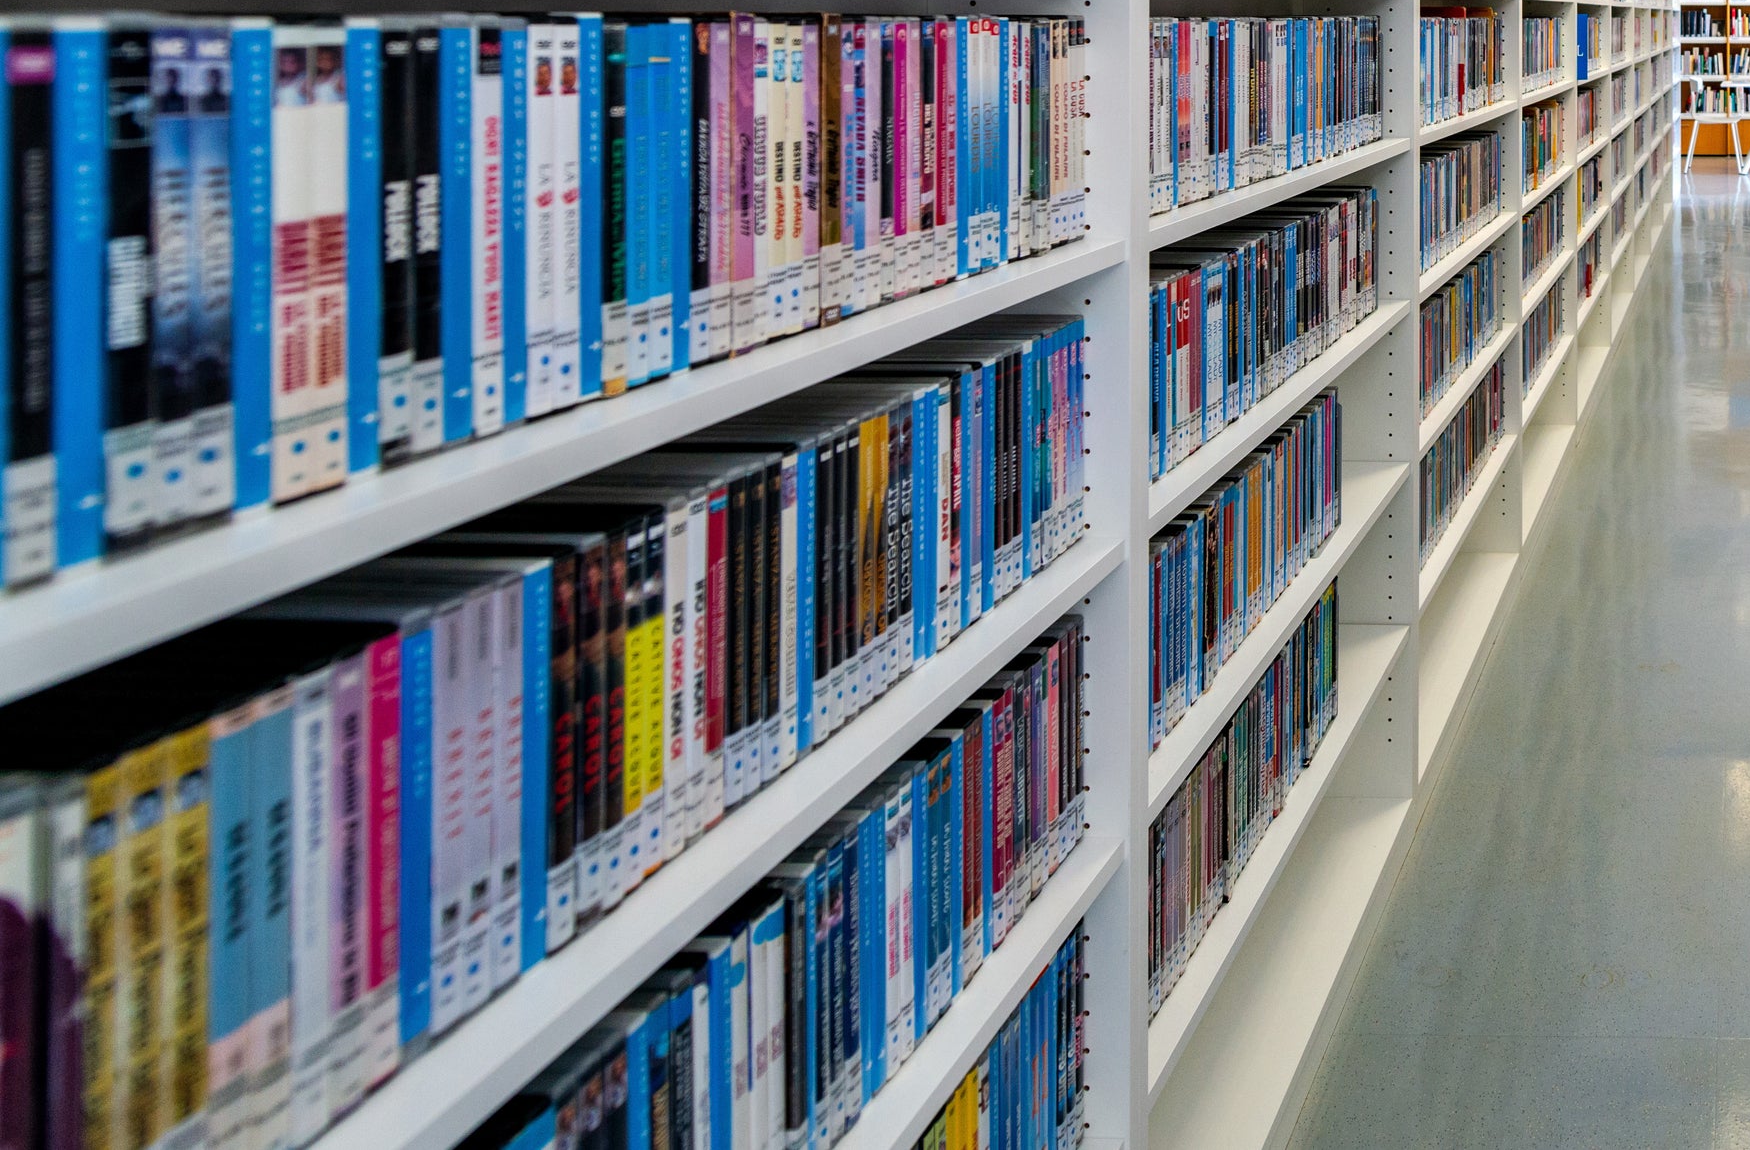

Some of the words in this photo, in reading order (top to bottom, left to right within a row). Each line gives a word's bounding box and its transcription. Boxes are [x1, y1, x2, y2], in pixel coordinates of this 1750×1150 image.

[855, 97, 866, 151] NEVADA
[948, 94, 956, 107] IL
[948, 112, 956, 126] 13
[754, 114, 767, 176] CIRCUS
[948, 131, 956, 151] NON
[971, 106, 980, 173] LOURDES
[1054, 123, 1059, 133] DI
[539, 164, 550, 186] LA
[855, 157, 866, 202] SMITH
[870, 126, 881, 183] Niagara
[948, 156, 956, 206] RISPONDE
[754, 179, 767, 236] WORLD
[539, 212, 550, 299] RINUNCIA
[888, 489, 898, 527] The
[888, 531, 898, 612] Search
[670, 602, 683, 635] QUI
[1181, 607, 1187, 618] DI
[629, 635, 641, 721] CATTIVE
[670, 637, 683, 690] SONO
[670, 693, 683, 736] NON
[555, 714, 574, 814] CAROL
[629, 733, 641, 800] ACQUE
[670, 739, 683, 761] IO
